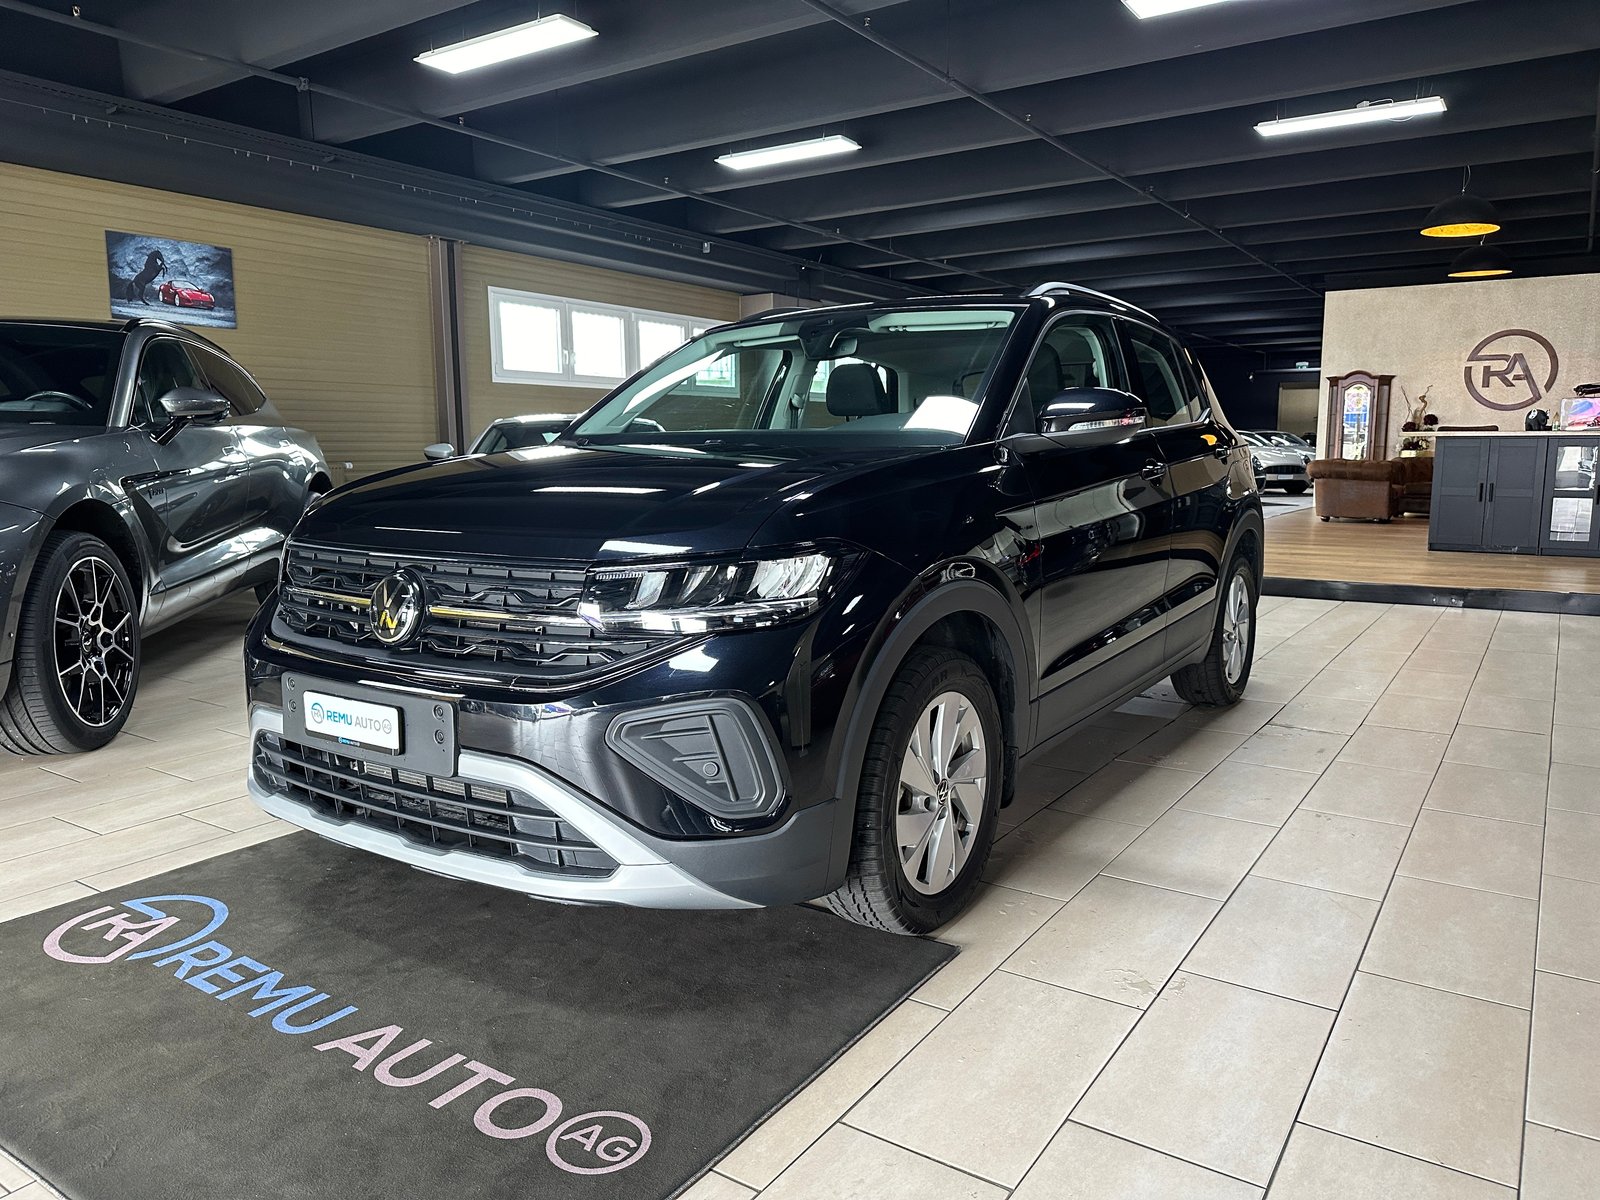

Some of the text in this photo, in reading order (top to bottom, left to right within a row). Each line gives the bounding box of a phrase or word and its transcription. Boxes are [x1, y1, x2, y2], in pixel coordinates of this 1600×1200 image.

[326, 709, 352, 726] REMU
[354, 716, 381, 731] AUTO
[153, 940, 359, 1035] REMU
[312, 1024, 564, 1140] AUTO
[561, 1123, 639, 1164] AG
